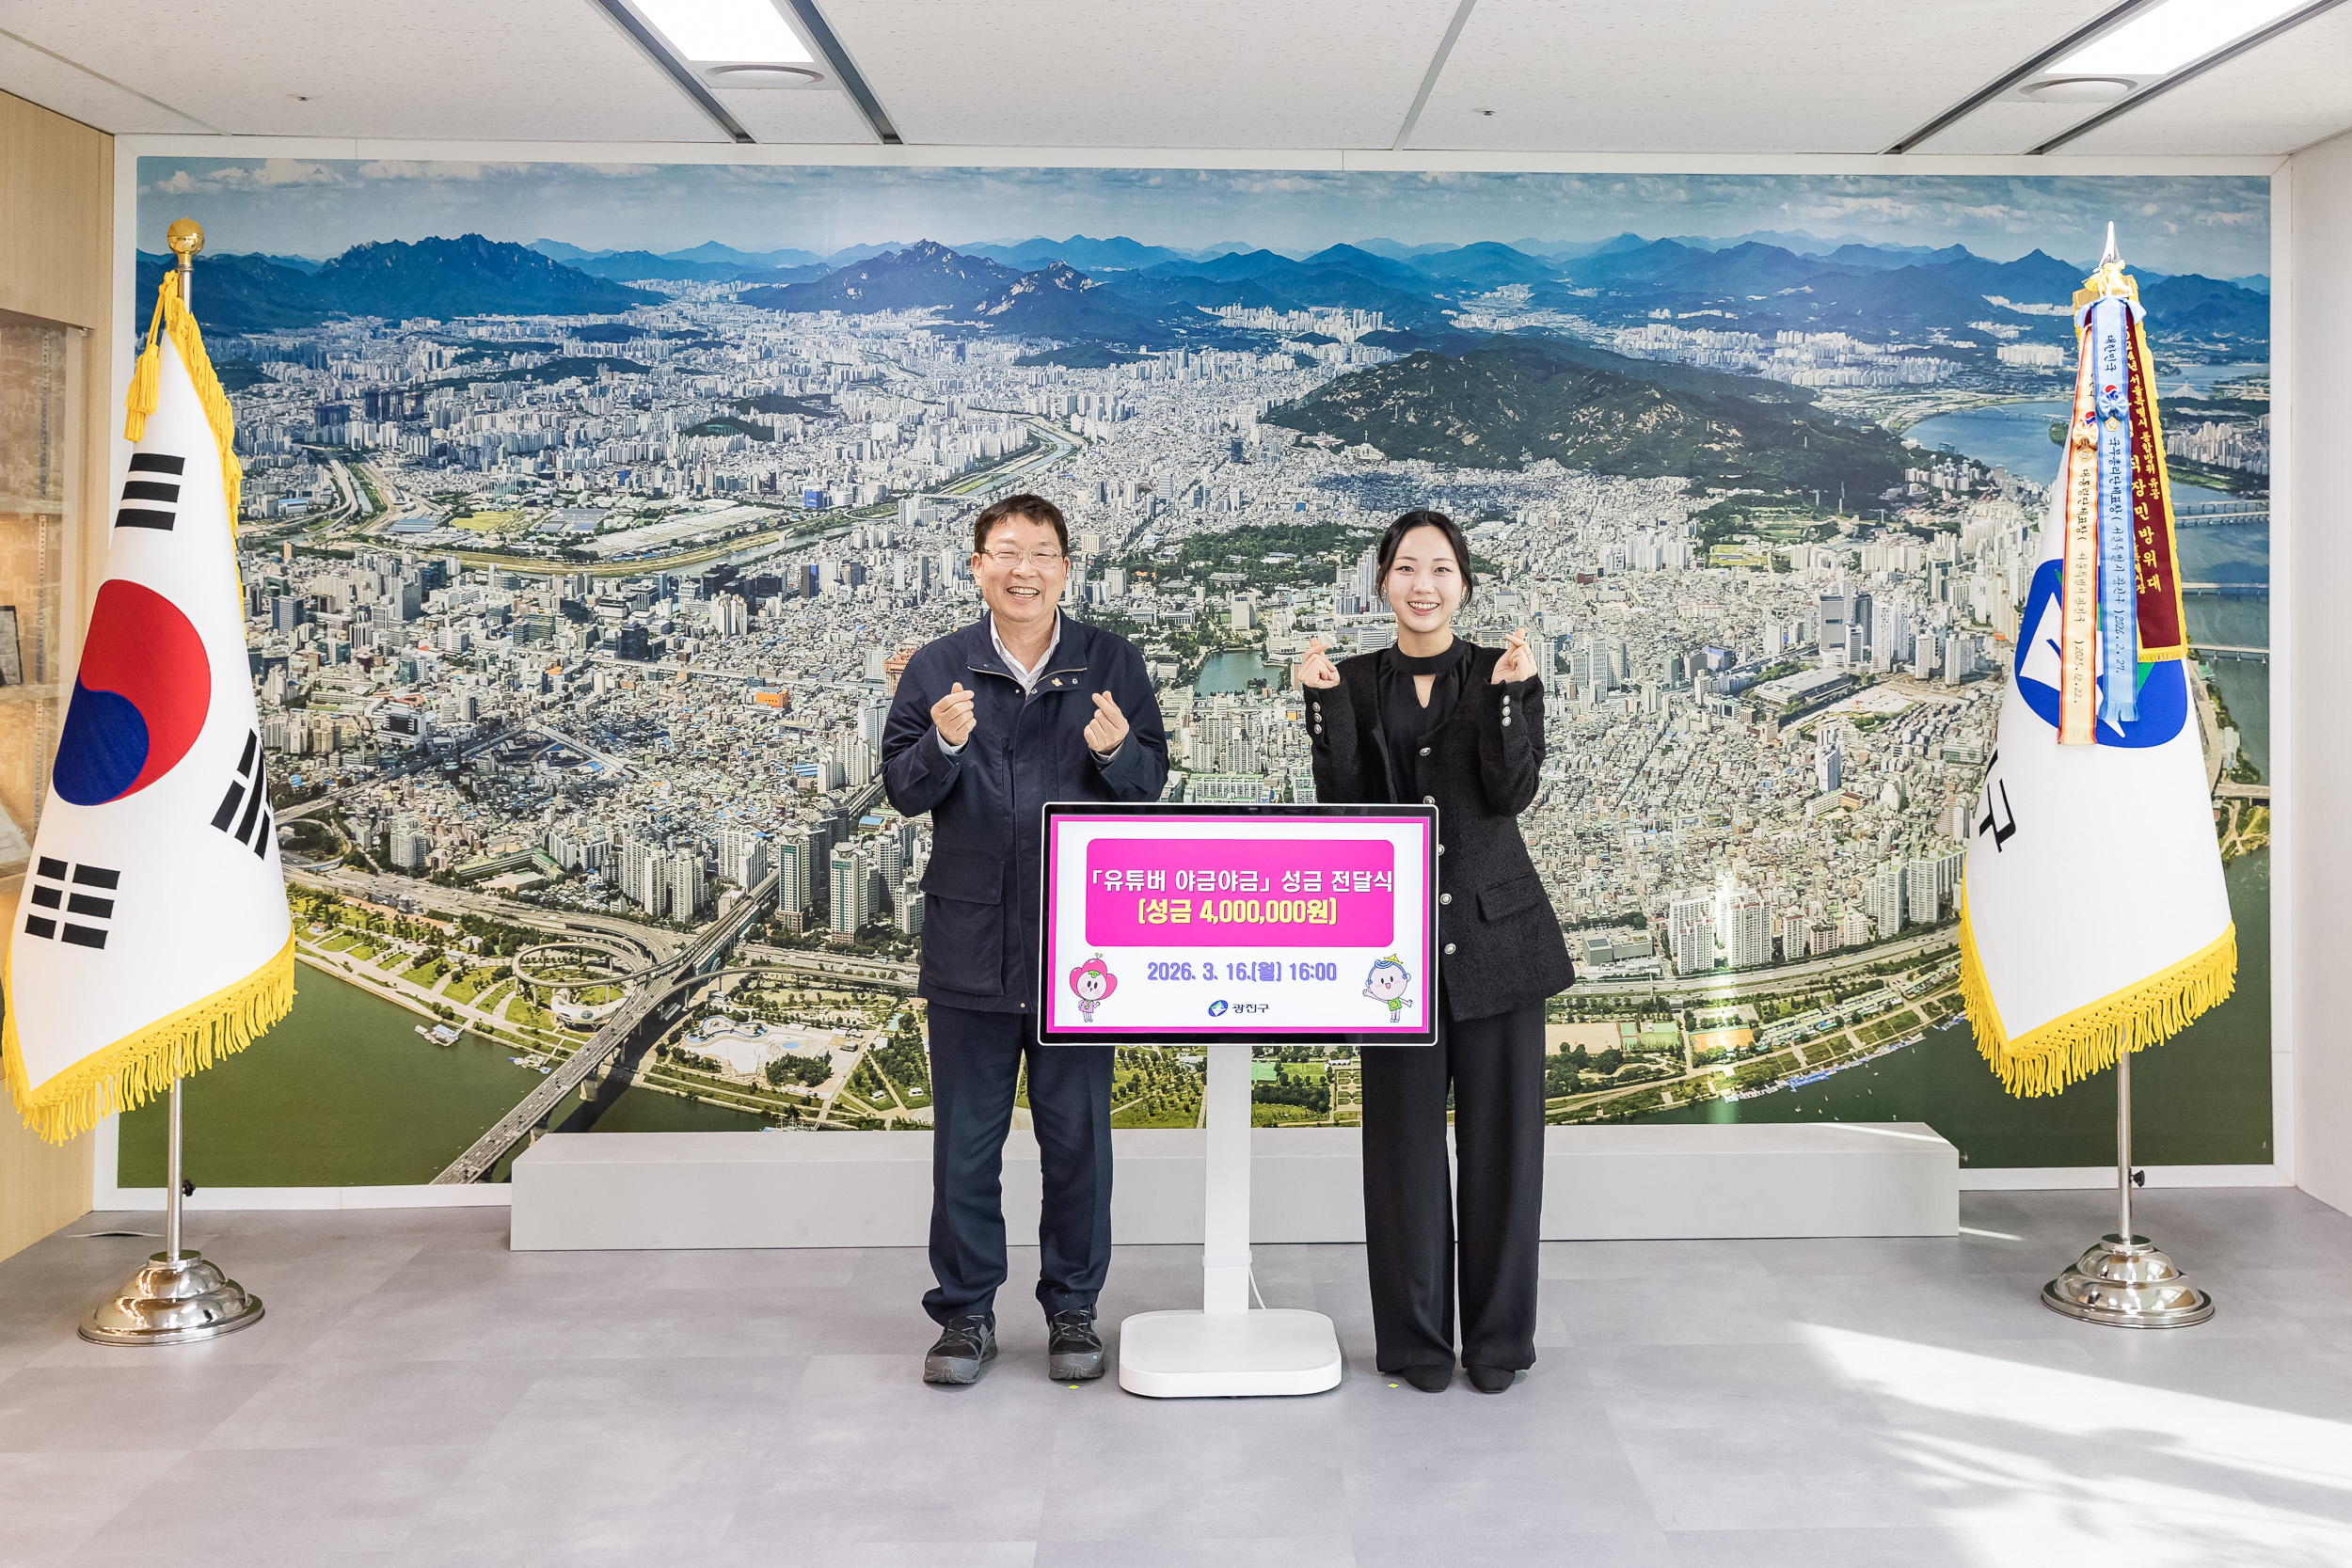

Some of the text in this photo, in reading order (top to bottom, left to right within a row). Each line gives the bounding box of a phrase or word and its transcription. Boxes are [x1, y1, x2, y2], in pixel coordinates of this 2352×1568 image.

[2104, 335, 2117, 372] 대한민국
[2130, 374, 2148, 429] 서울특별시
[2140, 431, 2156, 474] 통합방위
[2148, 477, 2161, 500] 유공
[1092, 869, 1393, 893] 「유튜버 야금야금」 성금 전달식
[1147, 961, 1197, 981] 2026.
[1202, 962, 1218, 981] 3.
[1289, 962, 1338, 981] 16:00
[1232, 1003, 1270, 1014] 광진구
